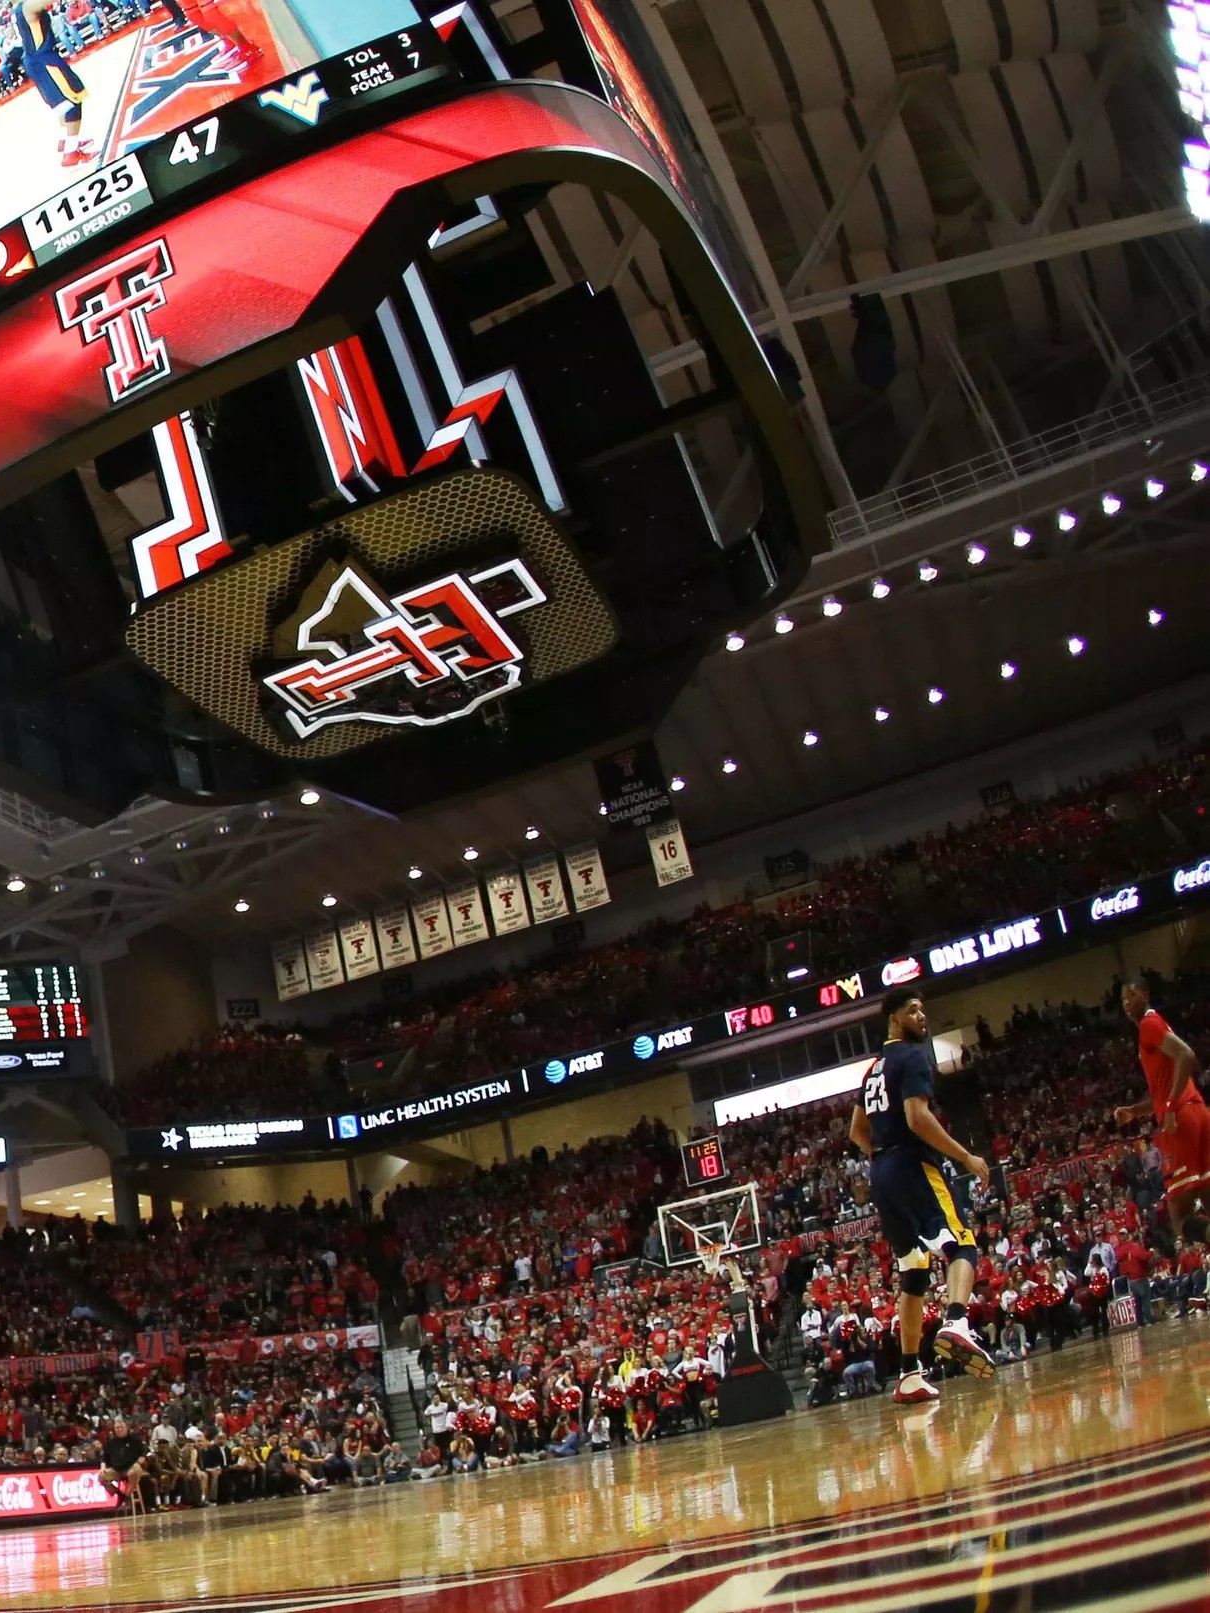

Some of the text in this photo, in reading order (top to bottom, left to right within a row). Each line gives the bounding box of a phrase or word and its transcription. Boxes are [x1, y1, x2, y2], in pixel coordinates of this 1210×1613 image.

[344, 33, 412, 68] TOL 3
[350, 52, 419, 95] FOULS 7
[351, 62, 390, 83] TEAM
[168, 116, 220, 166] 47
[35, 165, 133, 234] 11:25
[53, 202, 131, 253] 2ND PERIOD
[610, 788, 662, 808] NATIONAL
[621, 780, 644, 793] NCAA
[609, 796, 670, 823] CHAMPIONS
[660, 841, 677, 861] 16
[1091, 887, 1139, 920] Coca-Cola
[930, 938, 979, 973] ONE
[980, 918, 1041, 958] LOVE
[751, 1005, 773, 1026] 40
[788, 1006, 798, 1018] 2
[819, 984, 839, 1006] 47
[657, 1026, 693, 1051] AT&T
[569, 1051, 604, 1075] AT&T
[361, 1080, 510, 1130] UMC HEALTH SYSTEM
[865, 1073, 889, 1115] 23
[186, 1120, 303, 1138] TEXAS FARM BUREAU
[700, 1155, 718, 1177] 18
[51, 1472, 108, 1506] Coca-Cola
